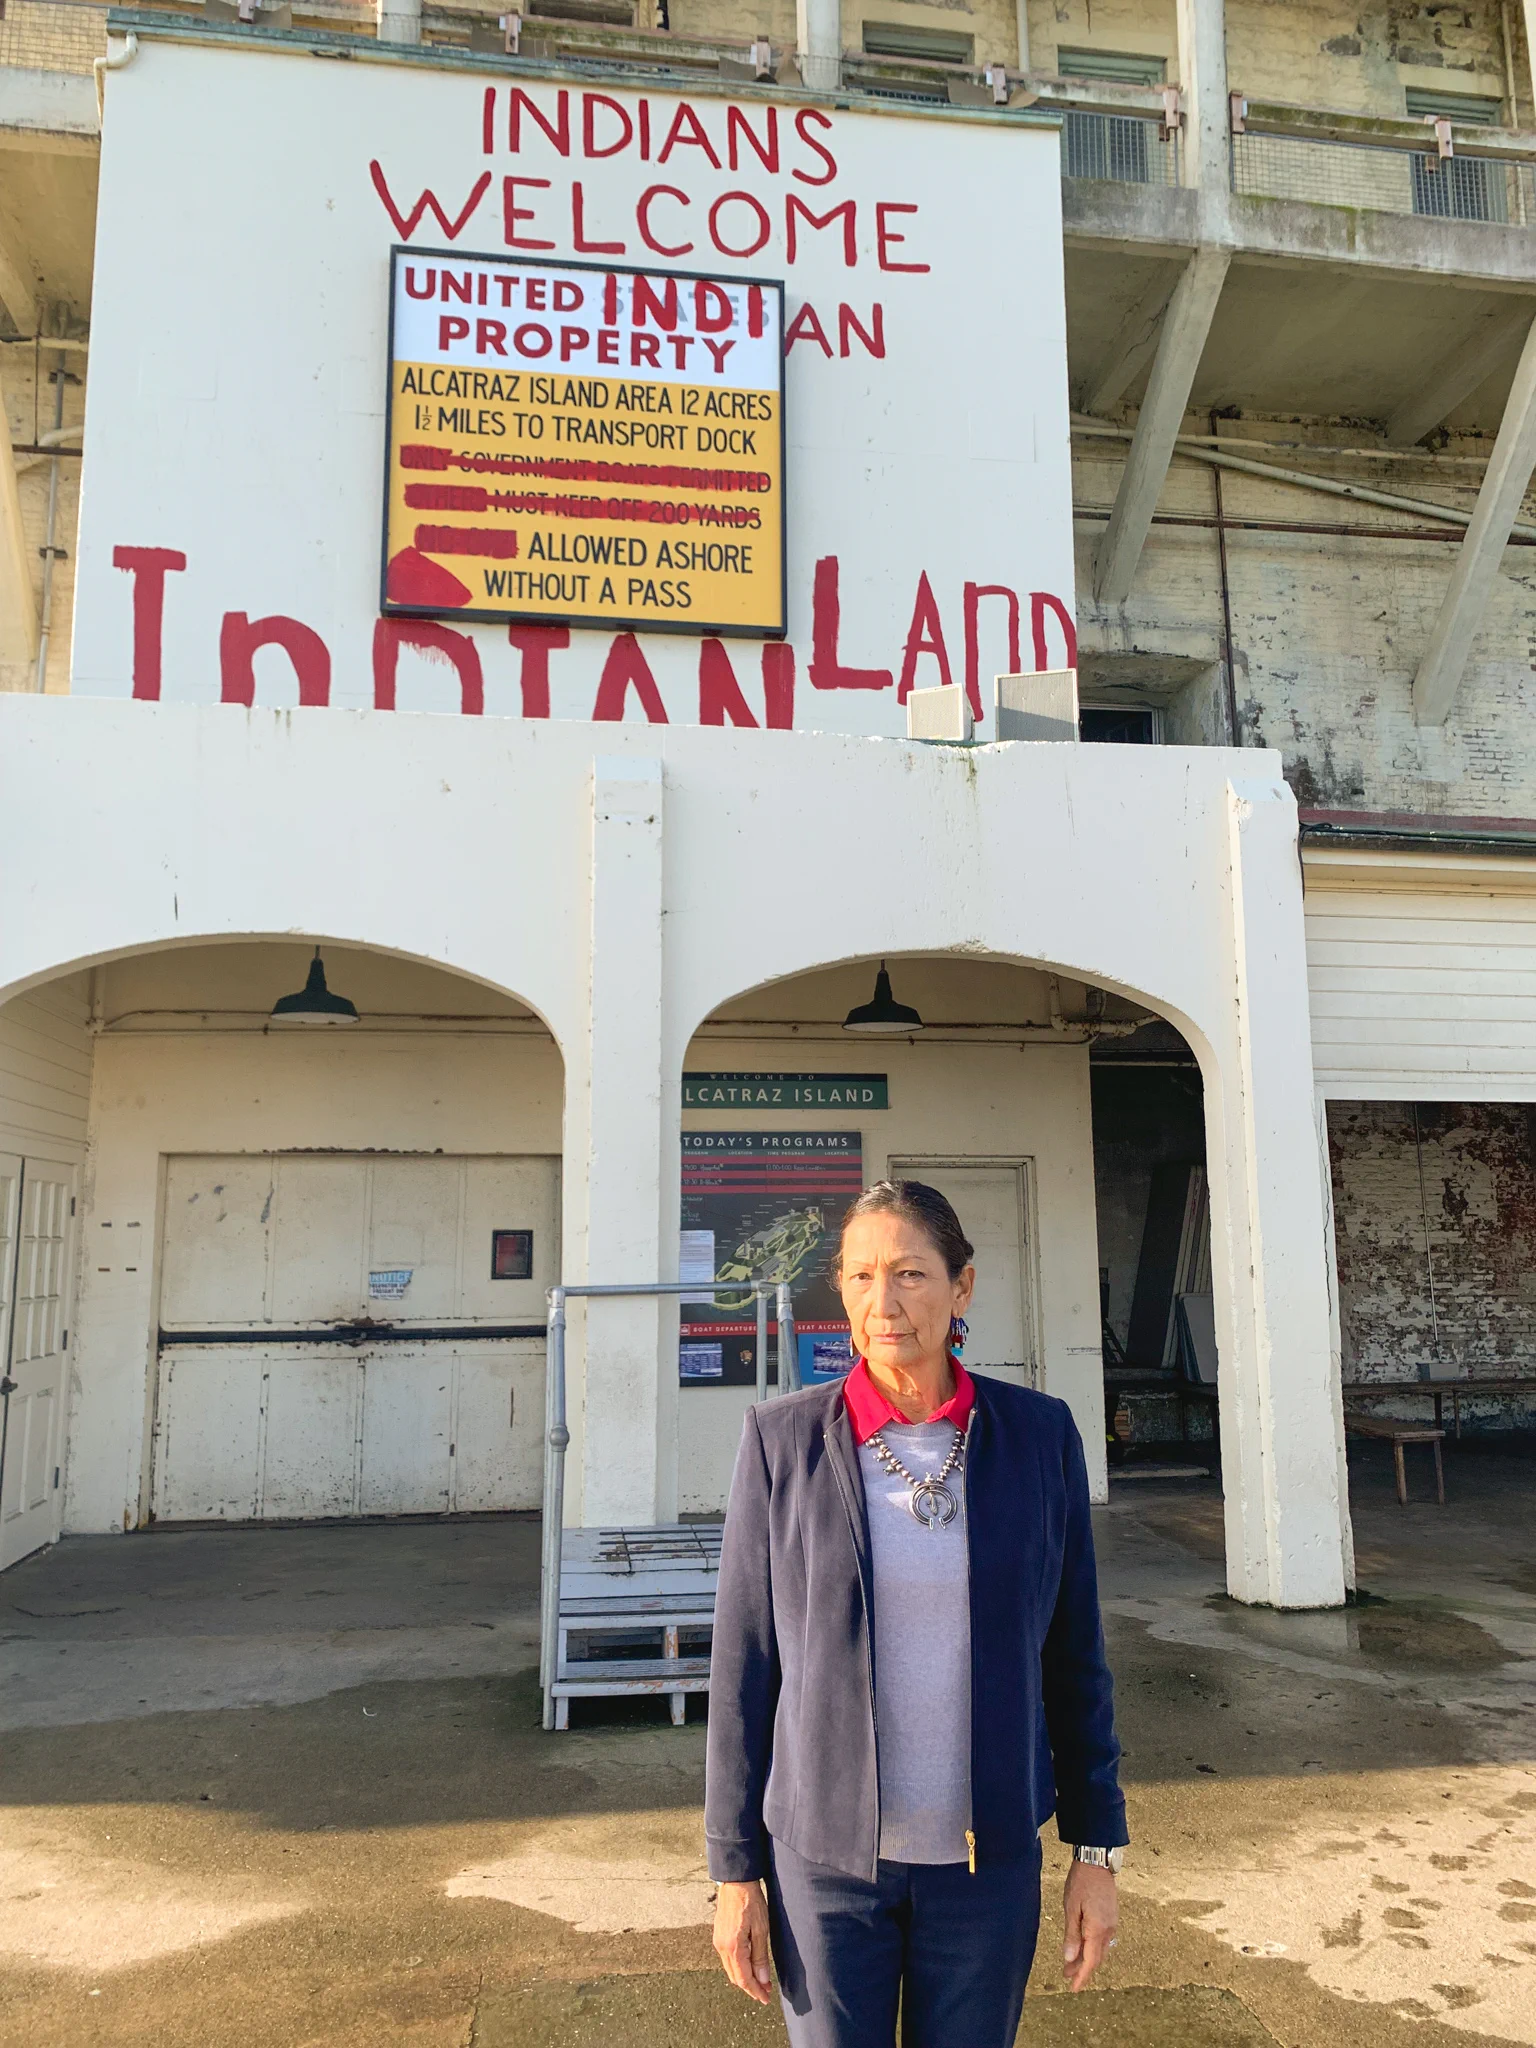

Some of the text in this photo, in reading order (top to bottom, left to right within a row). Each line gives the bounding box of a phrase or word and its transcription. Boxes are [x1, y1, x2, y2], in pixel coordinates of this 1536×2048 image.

[482, 86, 838, 186] INDIANS
[369, 159, 931, 274] WELCOME
[404, 266, 584, 312] UNITED
[437, 315, 737, 374] PROPERTY
[401, 367, 772, 421] ALCATRAZ ISLAND AREA 12 ACRES
[437, 406, 506, 437] MILES
[512, 412, 544, 440] TO
[551, 415, 689, 452] TRANSPORT
[697, 427, 757, 456] DOCK
[647, 500, 690, 526] 200
[694, 503, 762, 530] YARDS
[527, 531, 647, 568] ALLOWED
[656, 541, 753, 574] ASHORE
[484, 570, 692, 608] WITHOUT A PASS
[685, 1088, 874, 1103] LCATRAZ ISLAND
[762, 1137, 848, 1147] PROGRAMS
